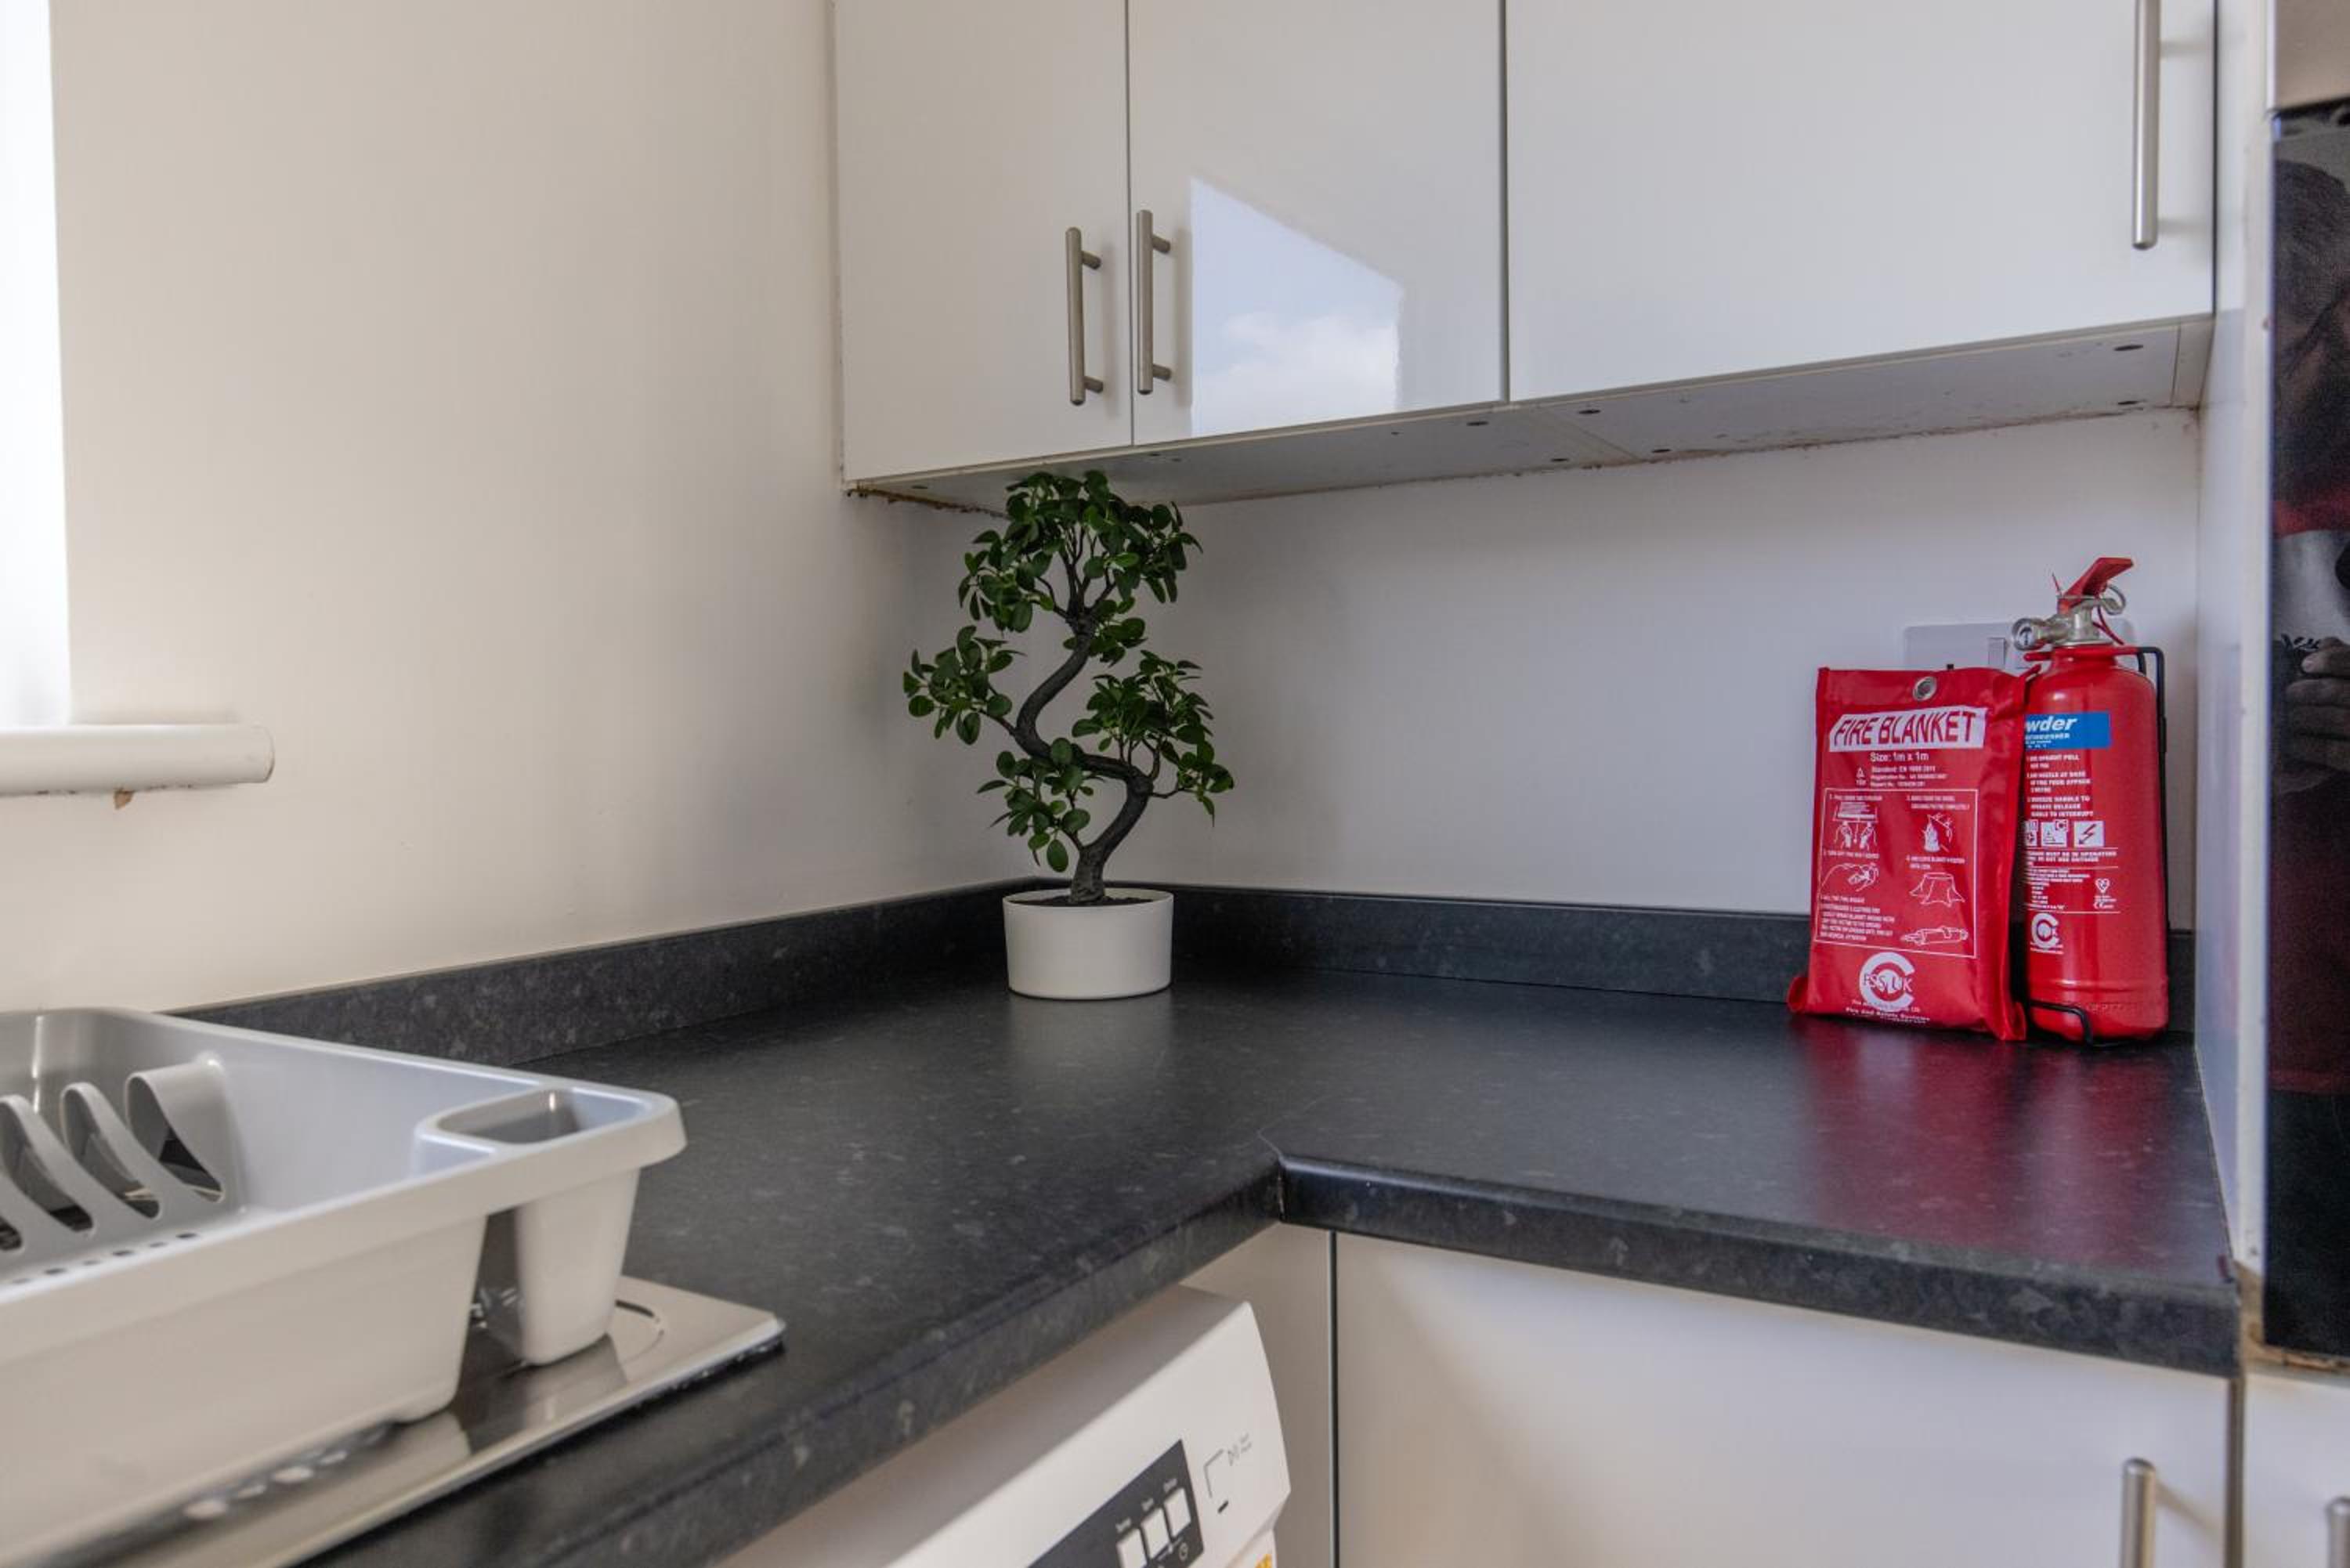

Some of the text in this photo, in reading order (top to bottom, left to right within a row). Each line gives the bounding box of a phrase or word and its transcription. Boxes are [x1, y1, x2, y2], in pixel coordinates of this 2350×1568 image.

[1834, 710, 1976, 746] FIRE BLANKET
[1870, 752, 1892, 762] Size:
[1893, 752, 1906, 761] 1m
[1915, 752, 1929, 761] 1m
